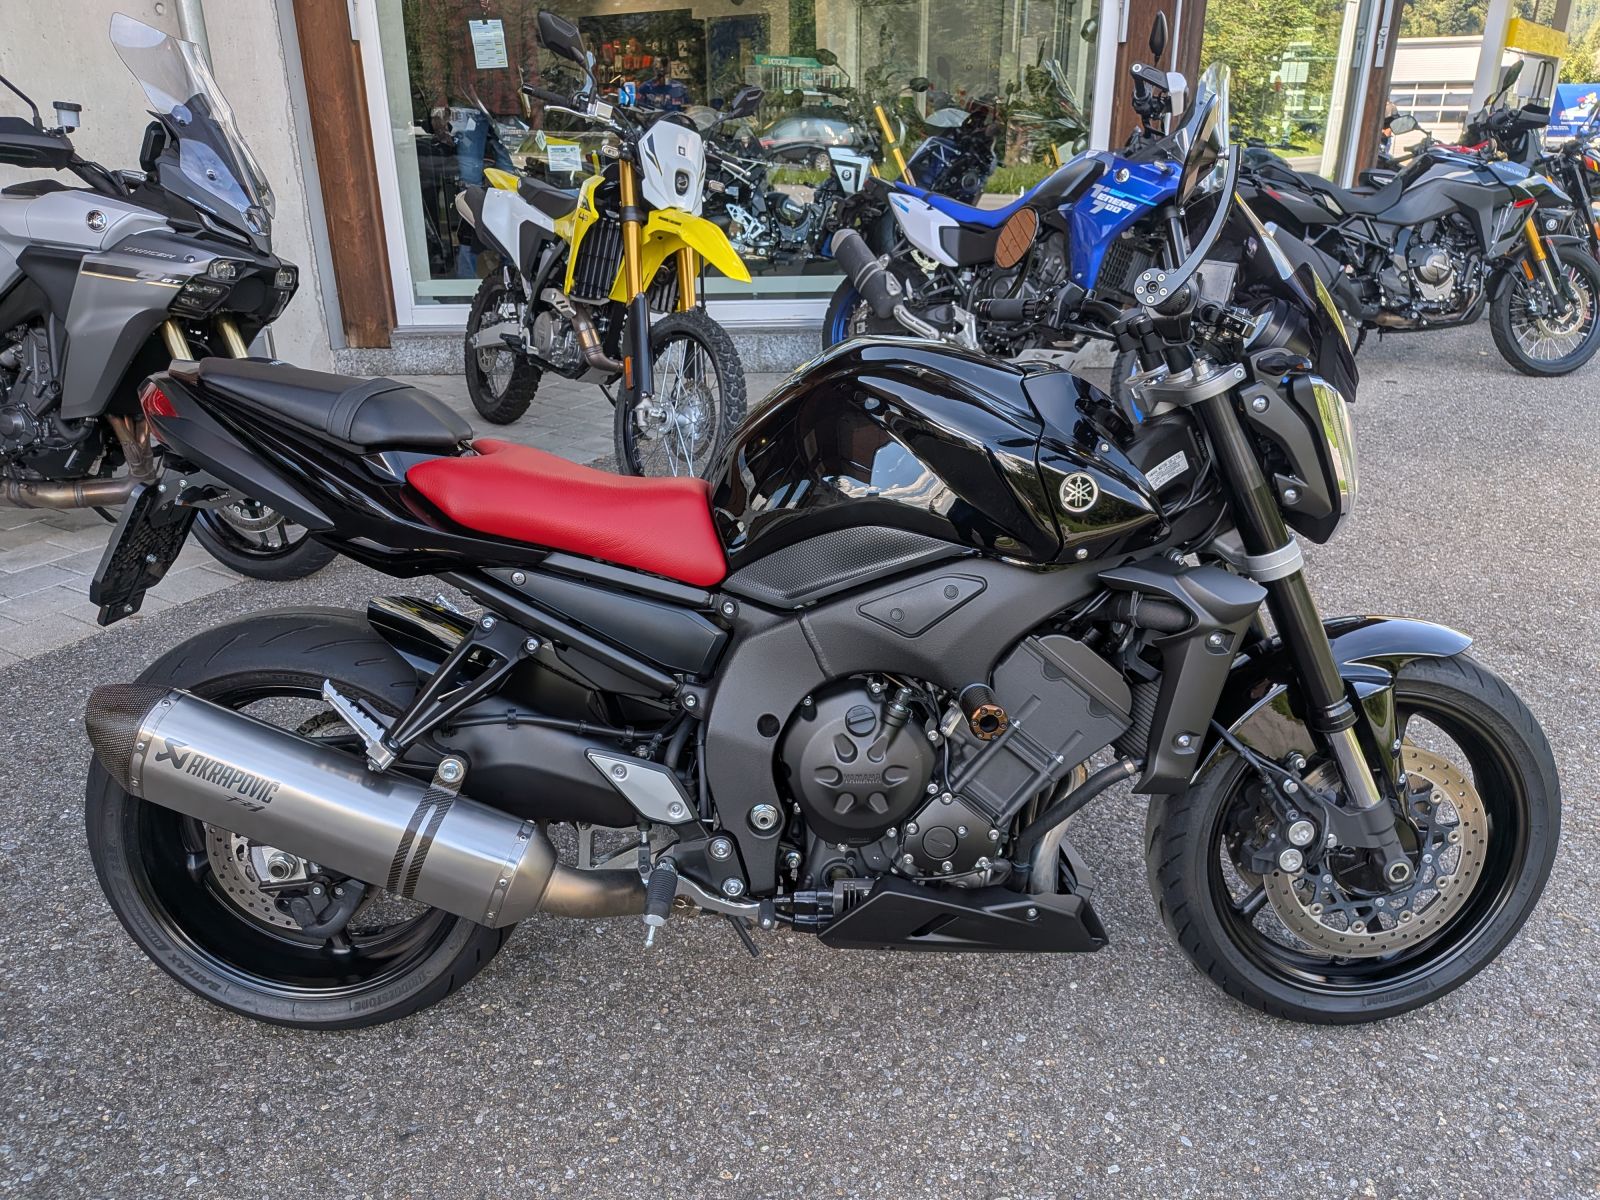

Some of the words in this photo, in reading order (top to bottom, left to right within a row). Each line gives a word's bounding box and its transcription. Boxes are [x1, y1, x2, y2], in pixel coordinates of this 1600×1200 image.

[1089, 199, 1122, 214] 700
[123, 246, 177, 259] TRACER
[160, 277, 184, 285] GT
[843, 773, 881, 784] YAMAHA
